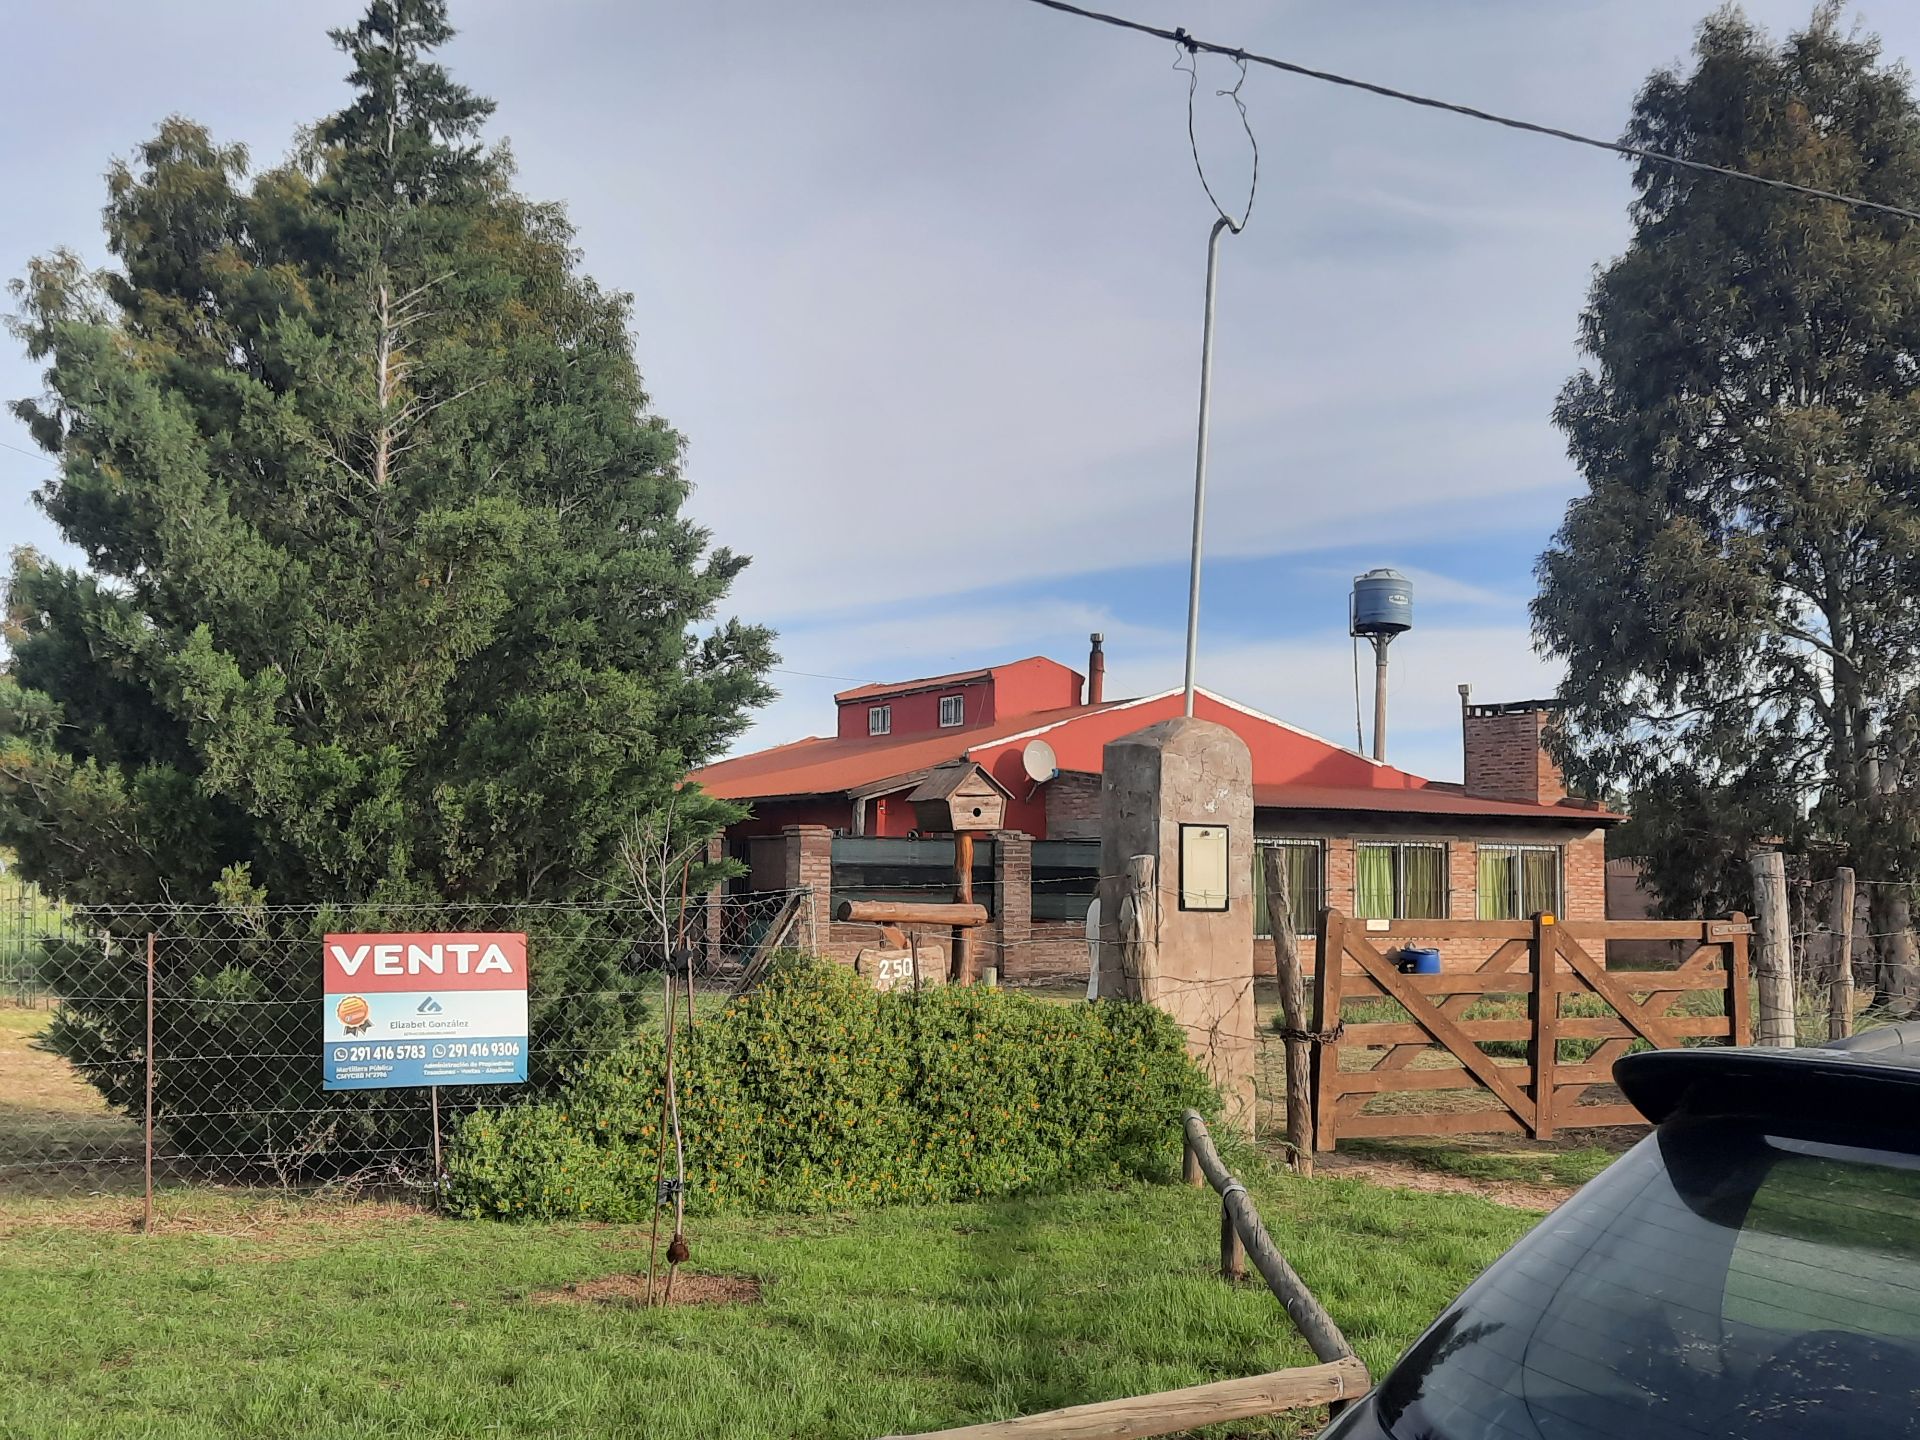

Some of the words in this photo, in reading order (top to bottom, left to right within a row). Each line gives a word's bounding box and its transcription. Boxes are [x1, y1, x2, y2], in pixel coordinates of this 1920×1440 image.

[329, 943, 513, 976] VENTA
[879, 957, 913, 979] 250
[390, 1020, 426, 1030] Elizabet
[428, 1018, 469, 1028] González
[350, 1046, 371, 1062] 291
[373, 1046, 394, 1060] 416
[396, 1044, 426, 1060] 5783
[448, 1043, 468, 1058] 291
[469, 1042, 489, 1057] 416
[491, 1041, 520, 1056] 9306
